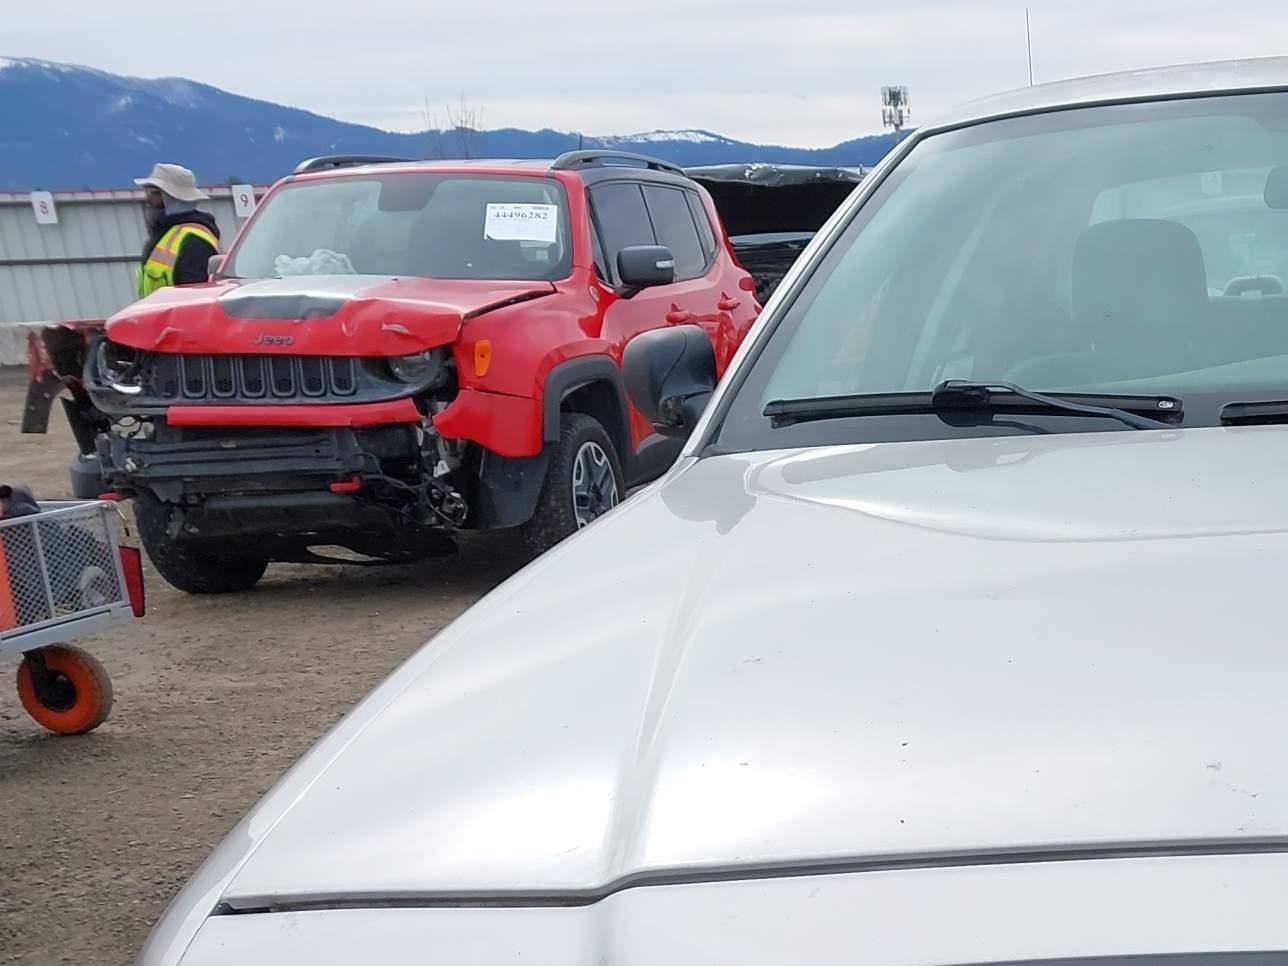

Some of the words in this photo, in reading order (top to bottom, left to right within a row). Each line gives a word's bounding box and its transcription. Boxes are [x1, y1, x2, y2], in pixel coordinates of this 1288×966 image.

[39, 200, 50, 216] 8
[239, 194, 250, 208] 9
[493, 211, 549, 220] 44496282
[252, 332, 296, 347] Jeep
